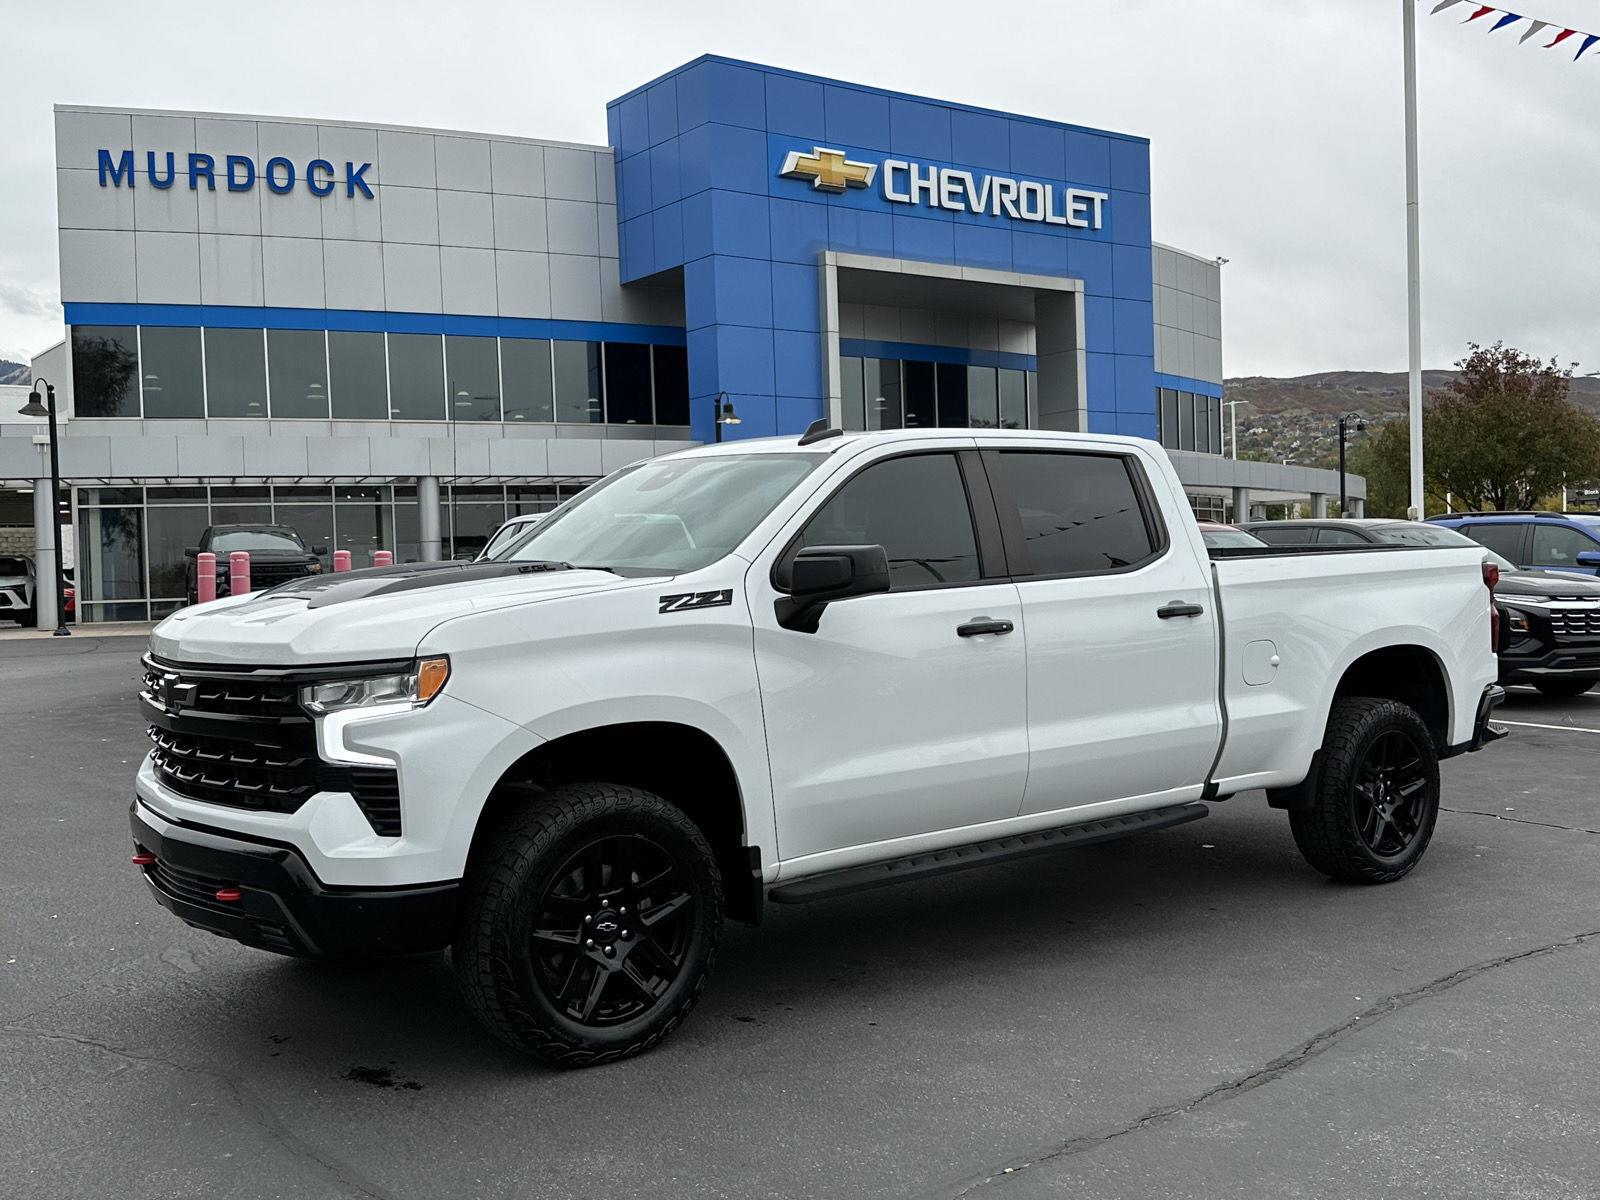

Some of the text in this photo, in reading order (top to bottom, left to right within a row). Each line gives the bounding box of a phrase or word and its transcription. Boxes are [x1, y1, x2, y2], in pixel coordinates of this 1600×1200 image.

[98, 149, 375, 199] MURDOCK
[883, 159, 1108, 230] CHEVROLET
[658, 588, 734, 614] Z71
